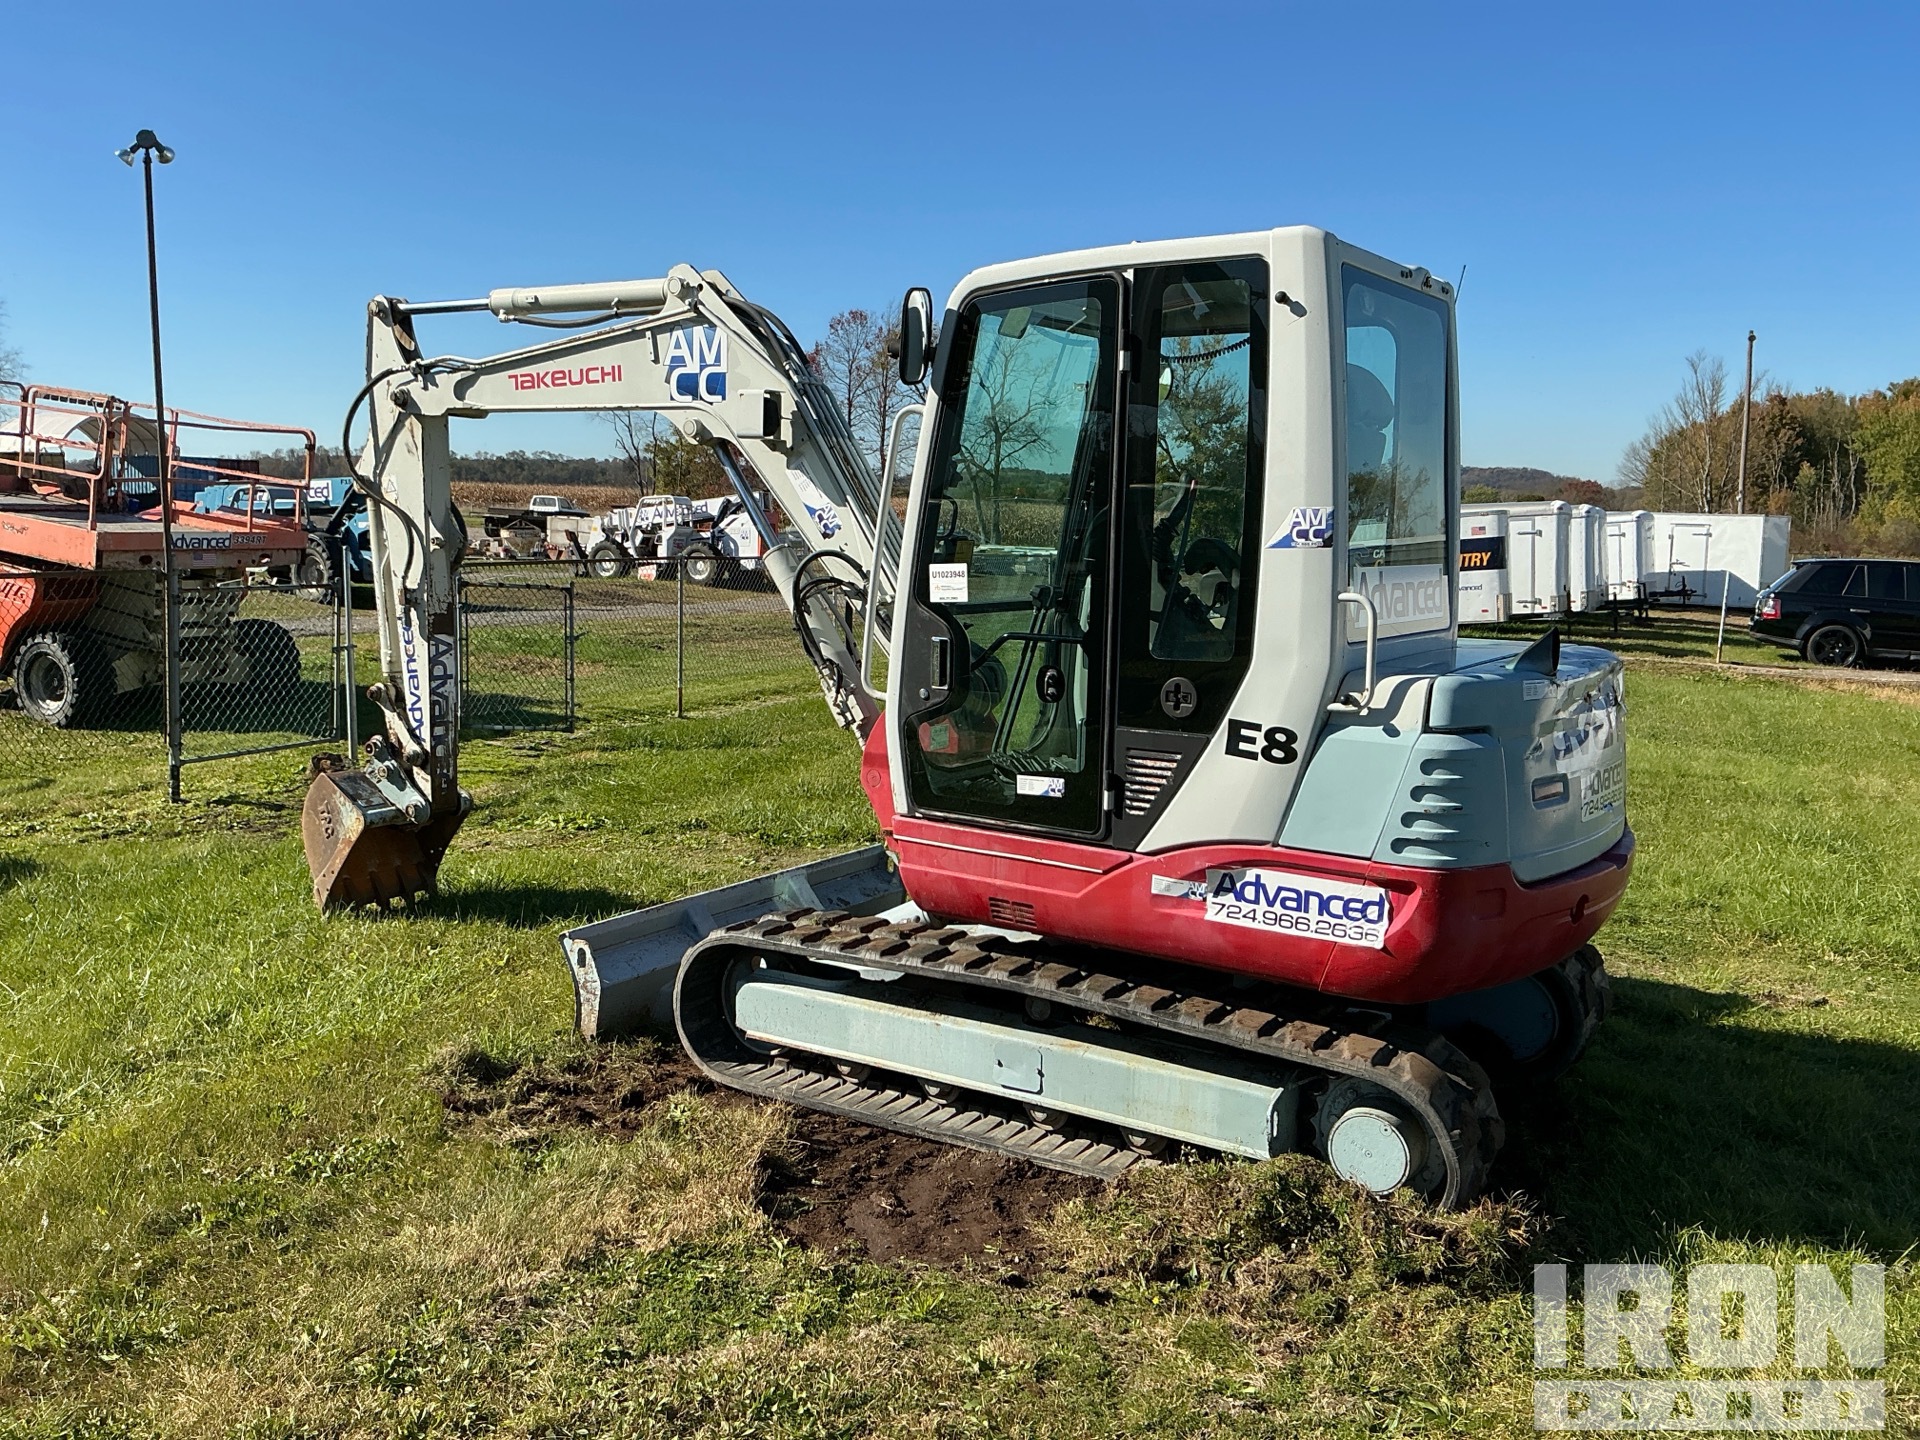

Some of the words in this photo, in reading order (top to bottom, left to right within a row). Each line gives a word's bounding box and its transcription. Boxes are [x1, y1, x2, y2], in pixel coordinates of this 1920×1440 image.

[234, 535, 267, 545] 3394RT
[932, 570, 965, 579] U1023948
[1356, 568, 1443, 621] Advanced
[1225, 718, 1298, 765] E8
[1213, 872, 1385, 924] Advanced
[1212, 902, 1381, 942] 724.966.2636
